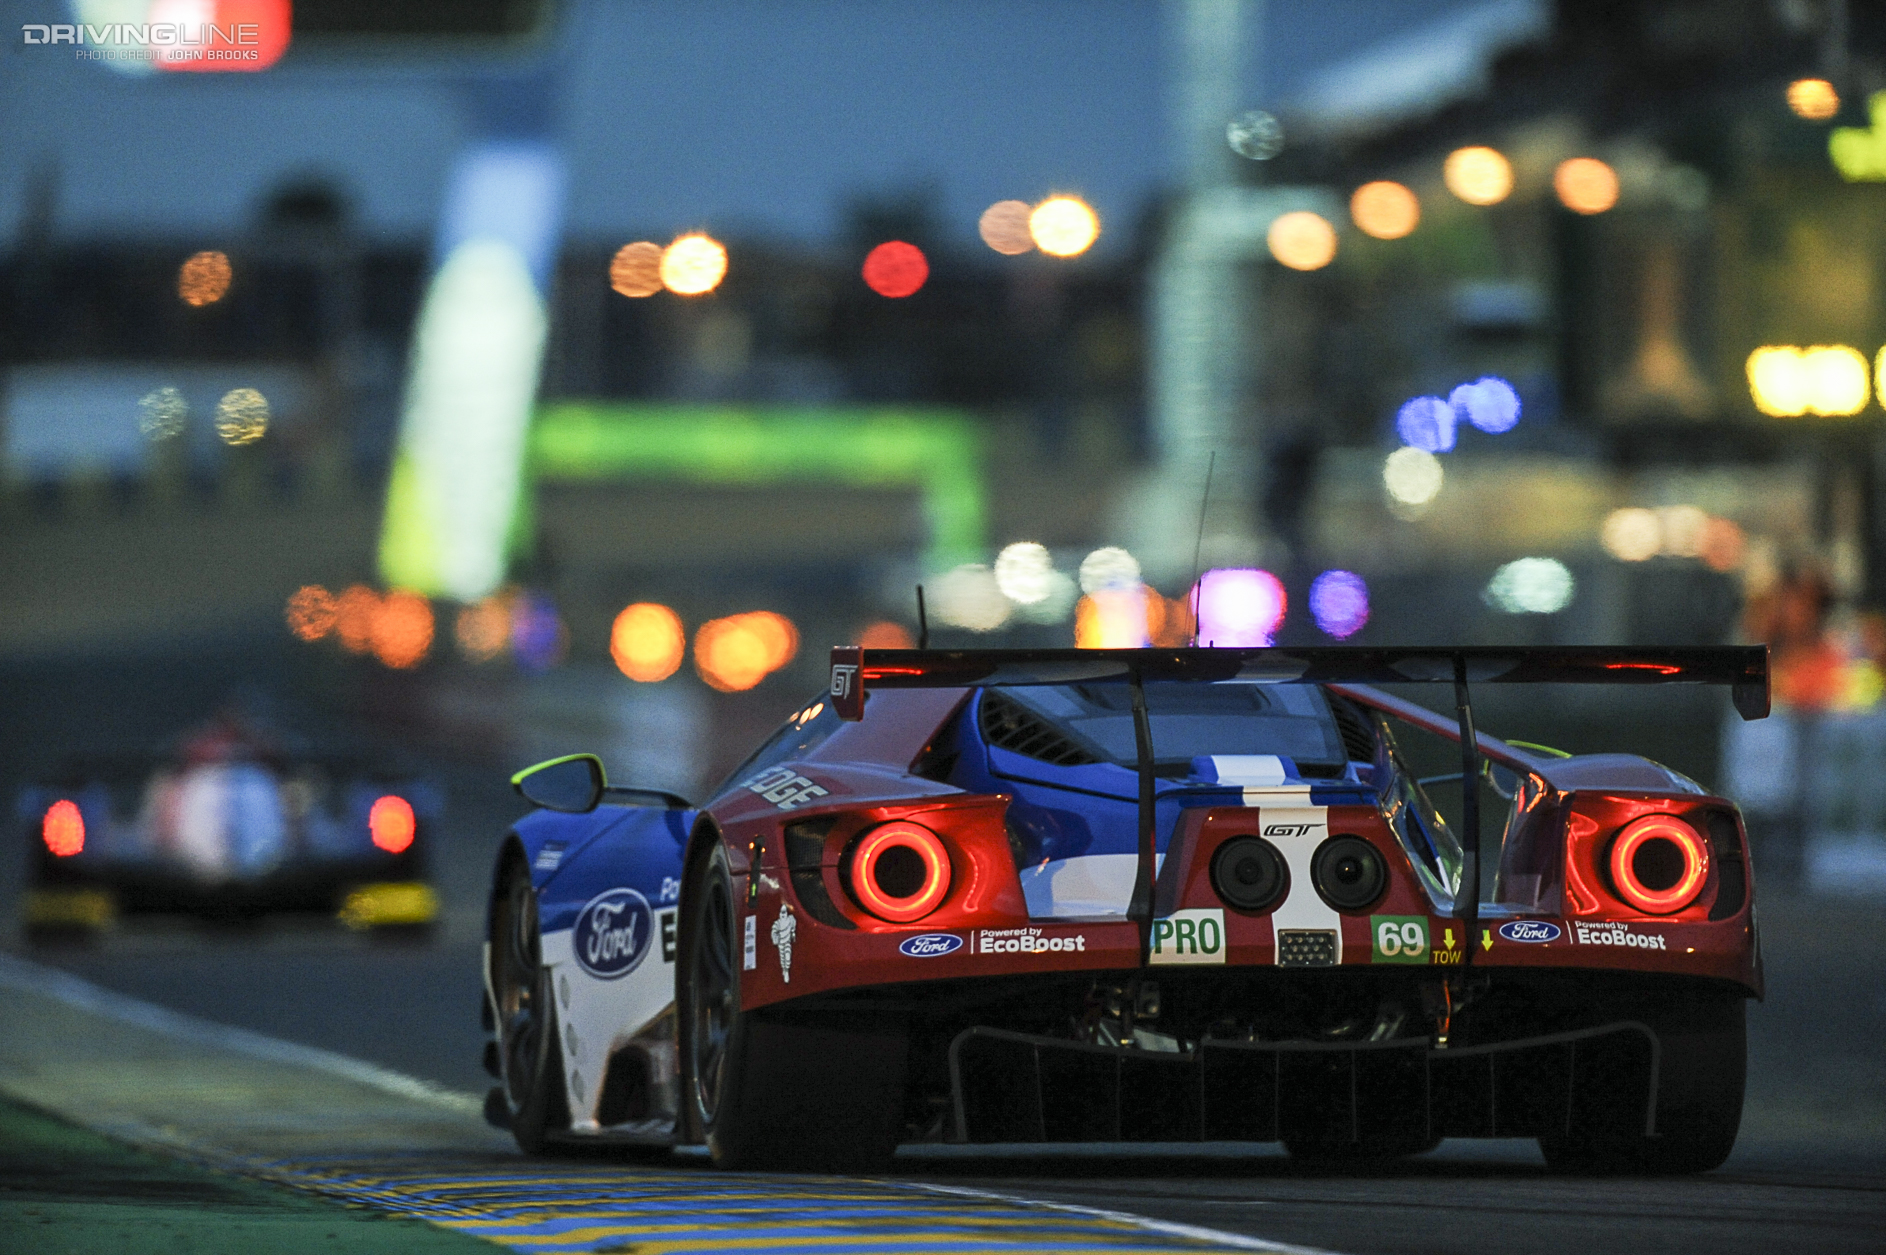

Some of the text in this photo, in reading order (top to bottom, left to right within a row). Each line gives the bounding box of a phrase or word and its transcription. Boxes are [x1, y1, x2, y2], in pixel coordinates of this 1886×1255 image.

[831, 664, 858, 700] GT
[1263, 823, 1326, 838] GT
[660, 876, 682, 903] Po
[587, 900, 638, 965] Ford
[980, 927, 1042, 938] Powered by
[1511, 923, 1549, 939] Ford
[1575, 920, 1629, 931] Powered by
[910, 936, 950, 954] Ford
[980, 934, 1085, 953] EcoBoost
[1153, 917, 1220, 954] PRO
[1378, 922, 1425, 957] 69
[1577, 928, 1667, 950] EcoBoost
[1433, 950, 1462, 964] TOW
